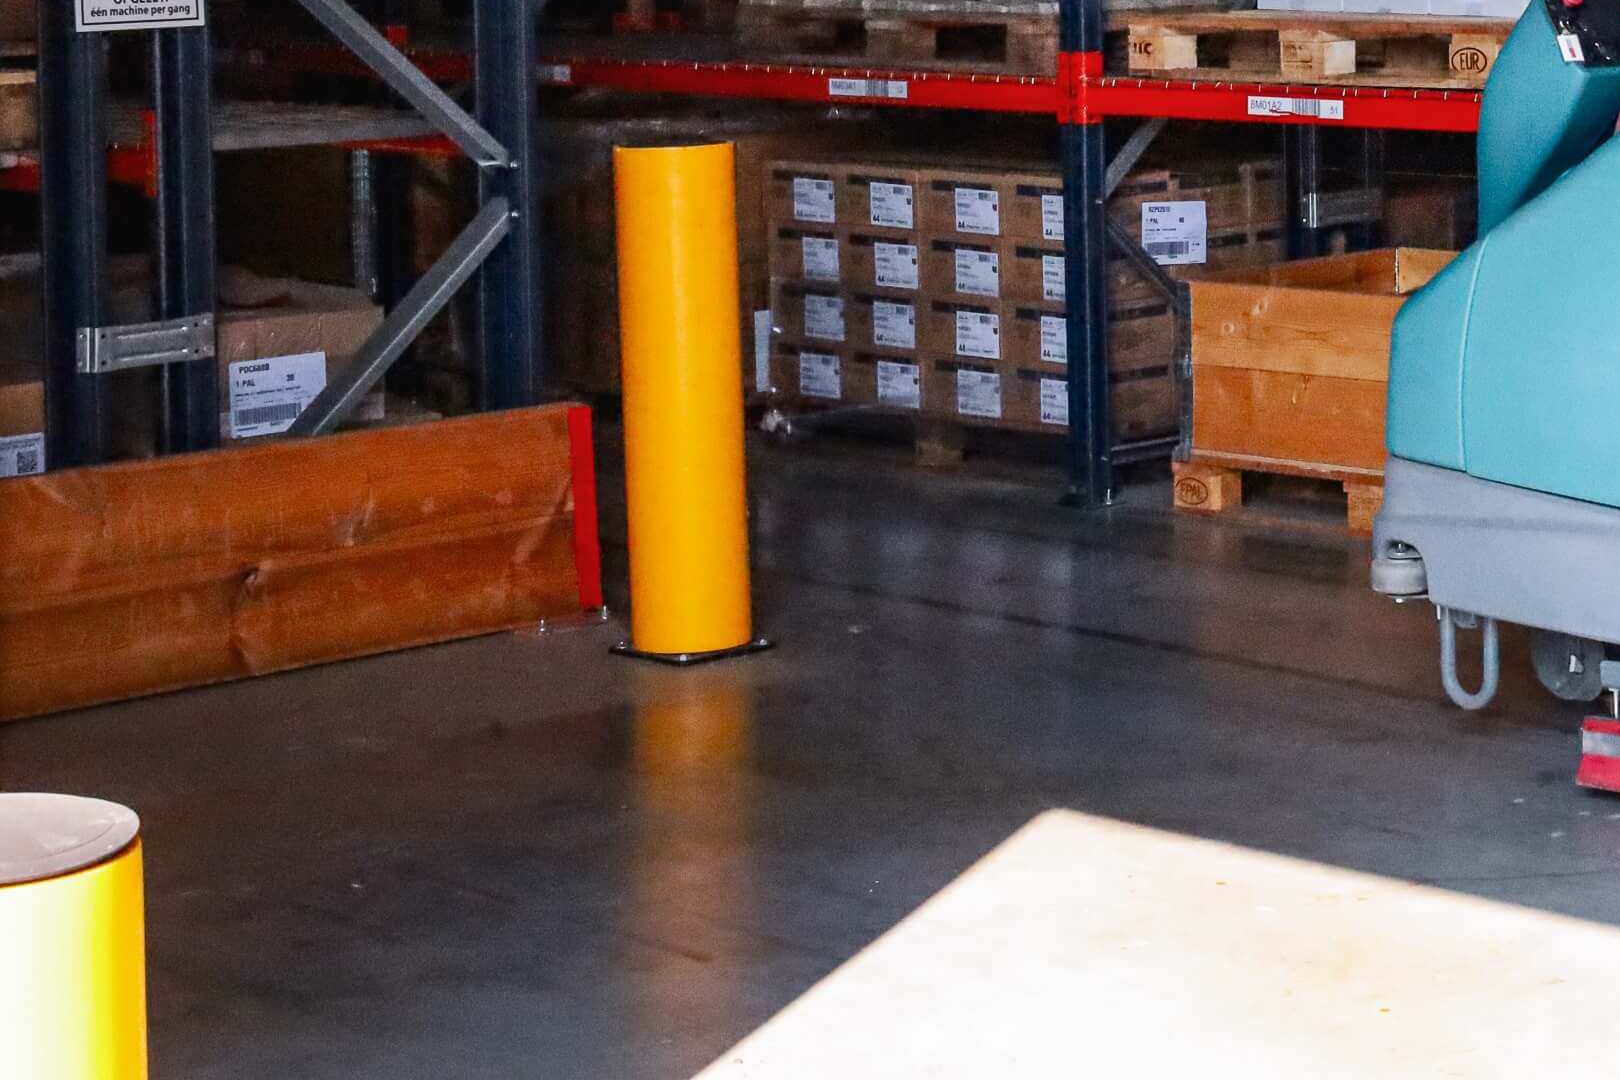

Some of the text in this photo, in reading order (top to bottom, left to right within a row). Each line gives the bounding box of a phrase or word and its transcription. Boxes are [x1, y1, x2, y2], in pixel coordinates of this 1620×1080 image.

[91, 4, 191, 18] één machine per gang
[1459, 53, 1479, 70] EUR
